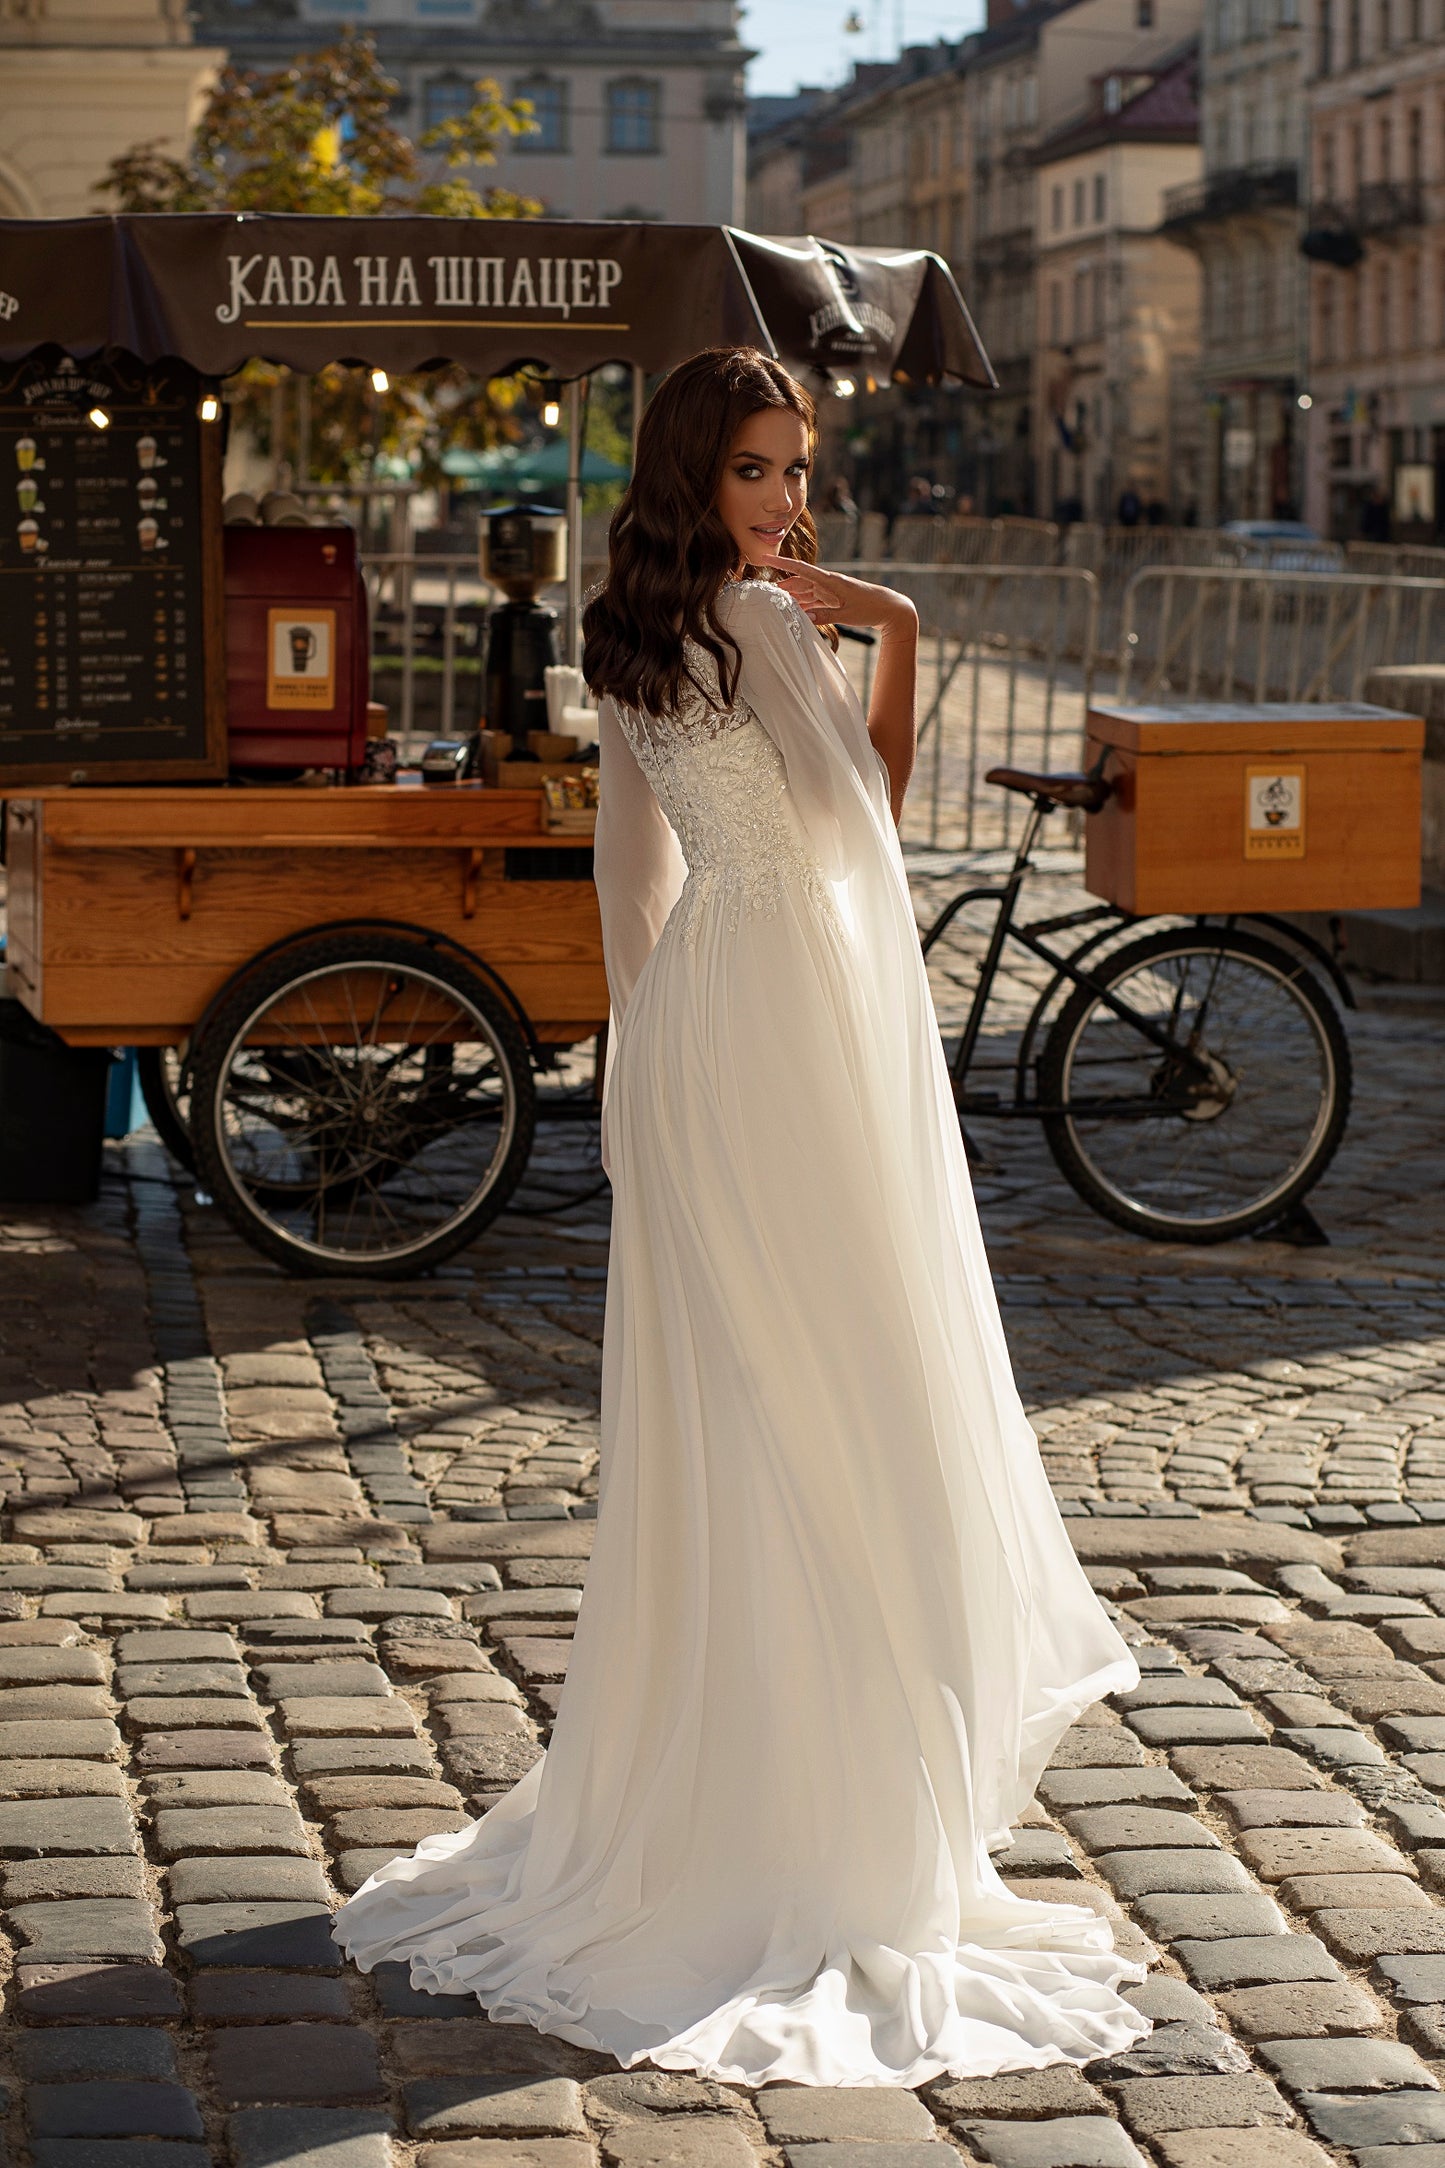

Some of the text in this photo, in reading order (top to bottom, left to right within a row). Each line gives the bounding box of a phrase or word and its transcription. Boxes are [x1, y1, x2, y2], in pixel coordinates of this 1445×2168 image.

[215, 254, 622, 323] КАВА НА ШПАЦЕР
